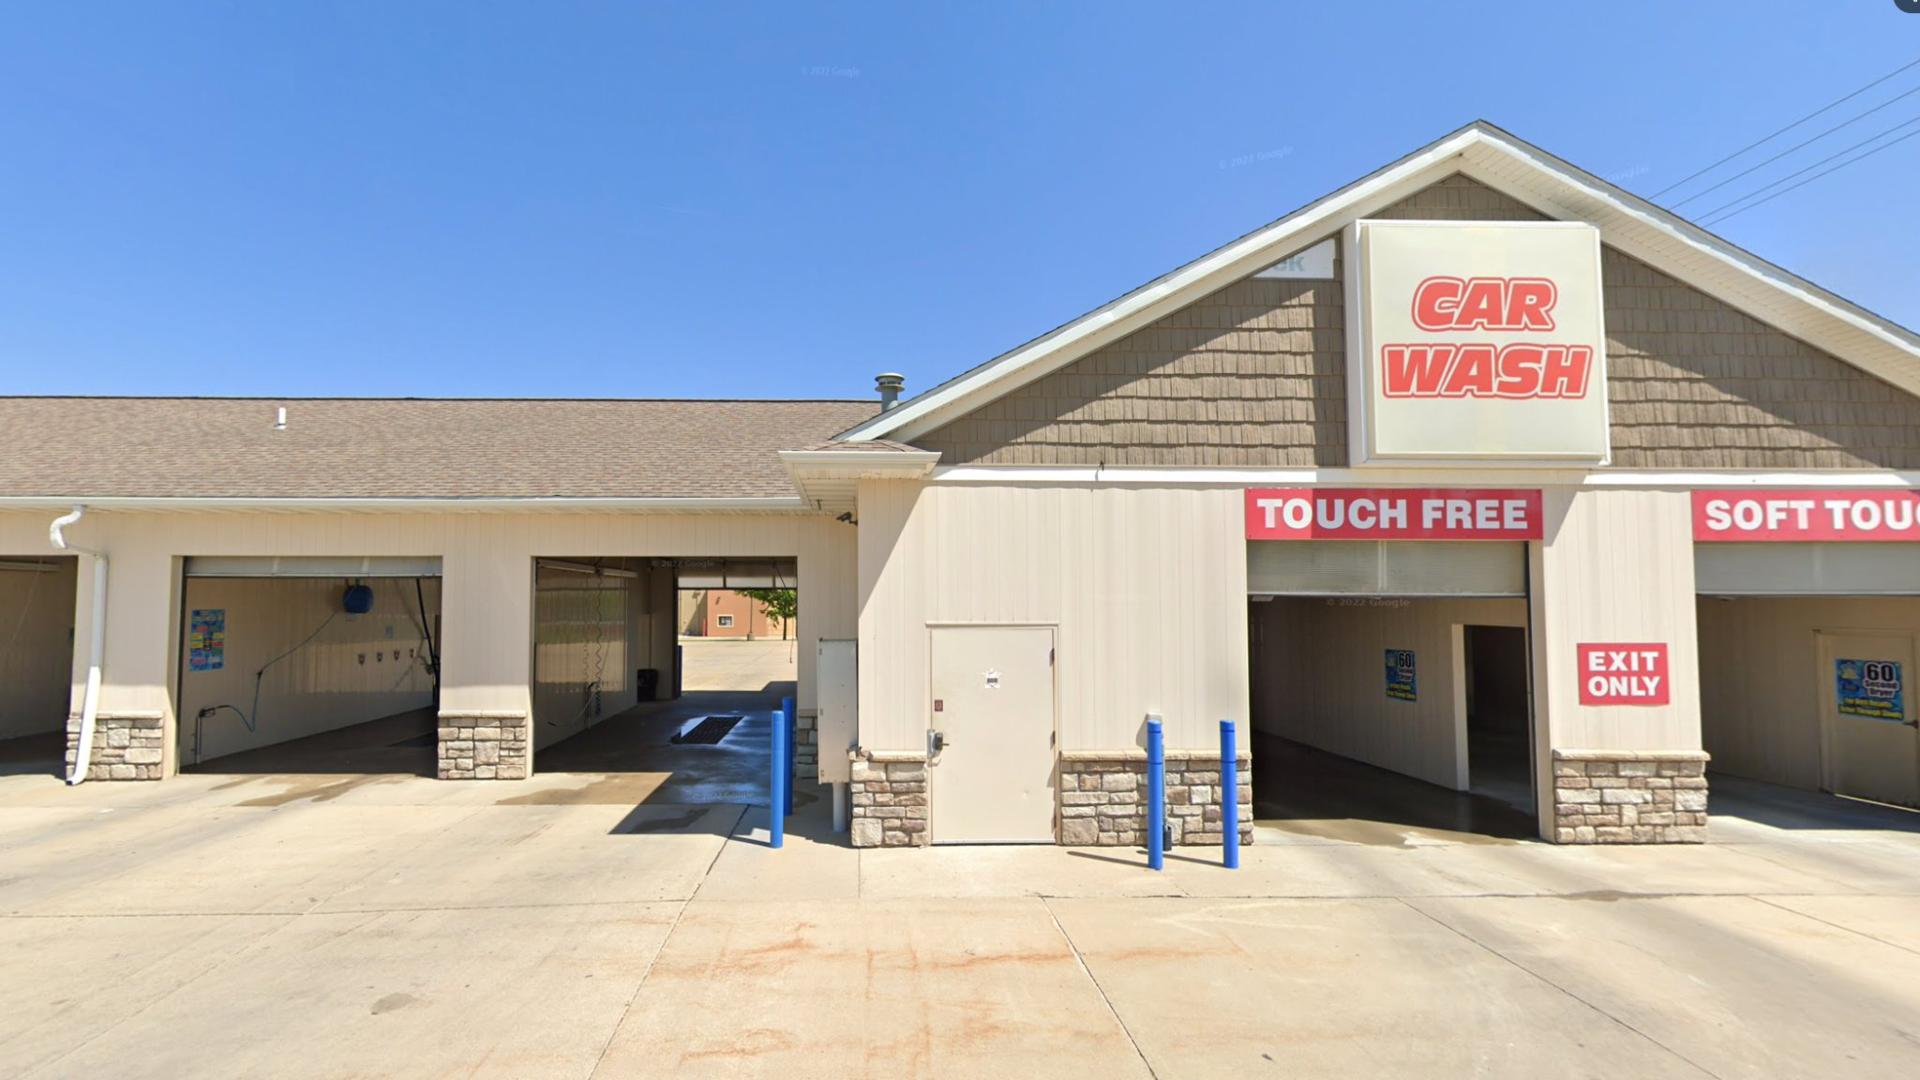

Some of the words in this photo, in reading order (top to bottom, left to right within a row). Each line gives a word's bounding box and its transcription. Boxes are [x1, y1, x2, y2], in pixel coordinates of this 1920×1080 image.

[1411, 276, 1558, 332] CAR
[1381, 343, 1593, 399] WASH
[1256, 498, 1407, 529] TOUCH
[1422, 498, 1528, 529] FREE
[1705, 499, 1815, 531] SOFT
[1824, 499, 1920, 531] TOU
[1398, 652, 1412, 668] 60
[1588, 651, 1659, 671] EXIT
[1865, 662, 1895, 682] 60
[1588, 676, 1660, 696] ONLY
